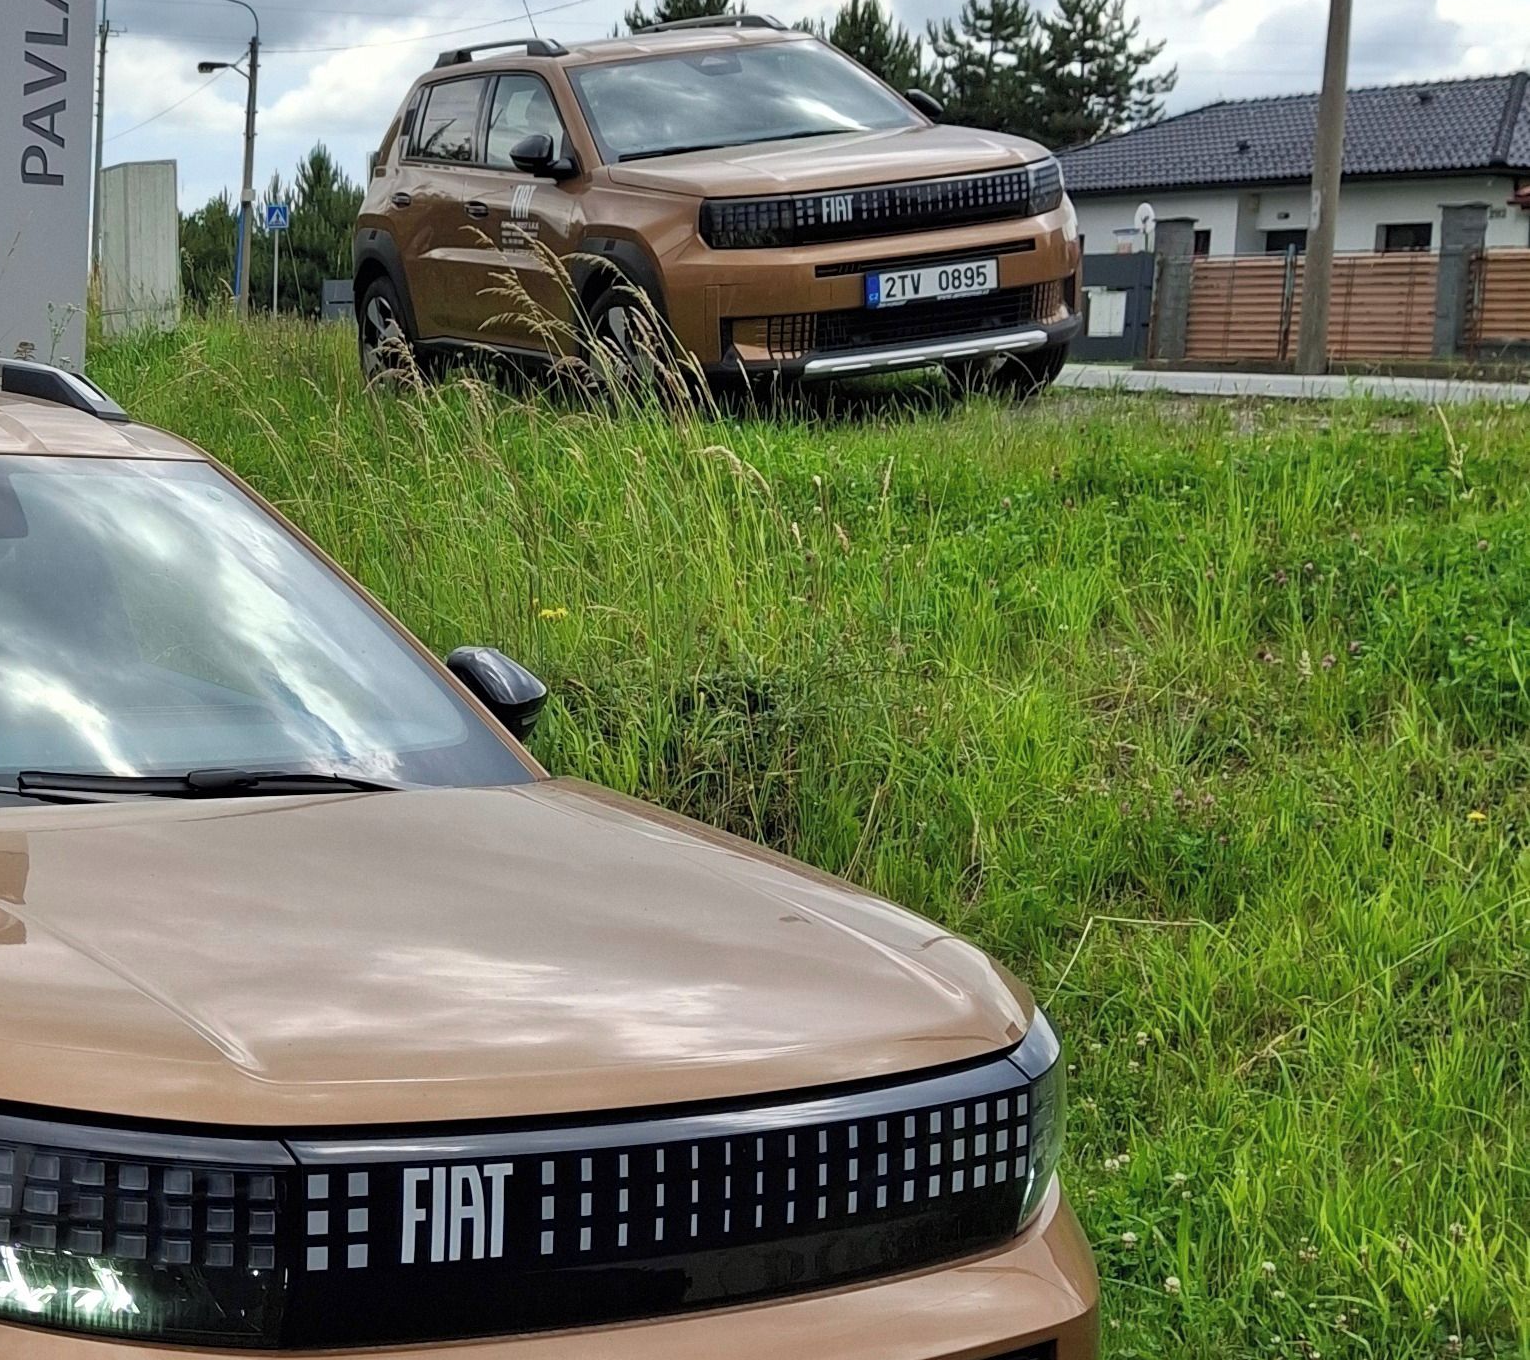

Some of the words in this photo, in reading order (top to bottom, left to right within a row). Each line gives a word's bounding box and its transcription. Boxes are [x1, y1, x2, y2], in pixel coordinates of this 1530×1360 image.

[821, 194, 855, 224] FIAT
[884, 272, 921, 299] 2TV
[938, 264, 987, 291] 0895
[401, 1161, 515, 1265] FIAT
